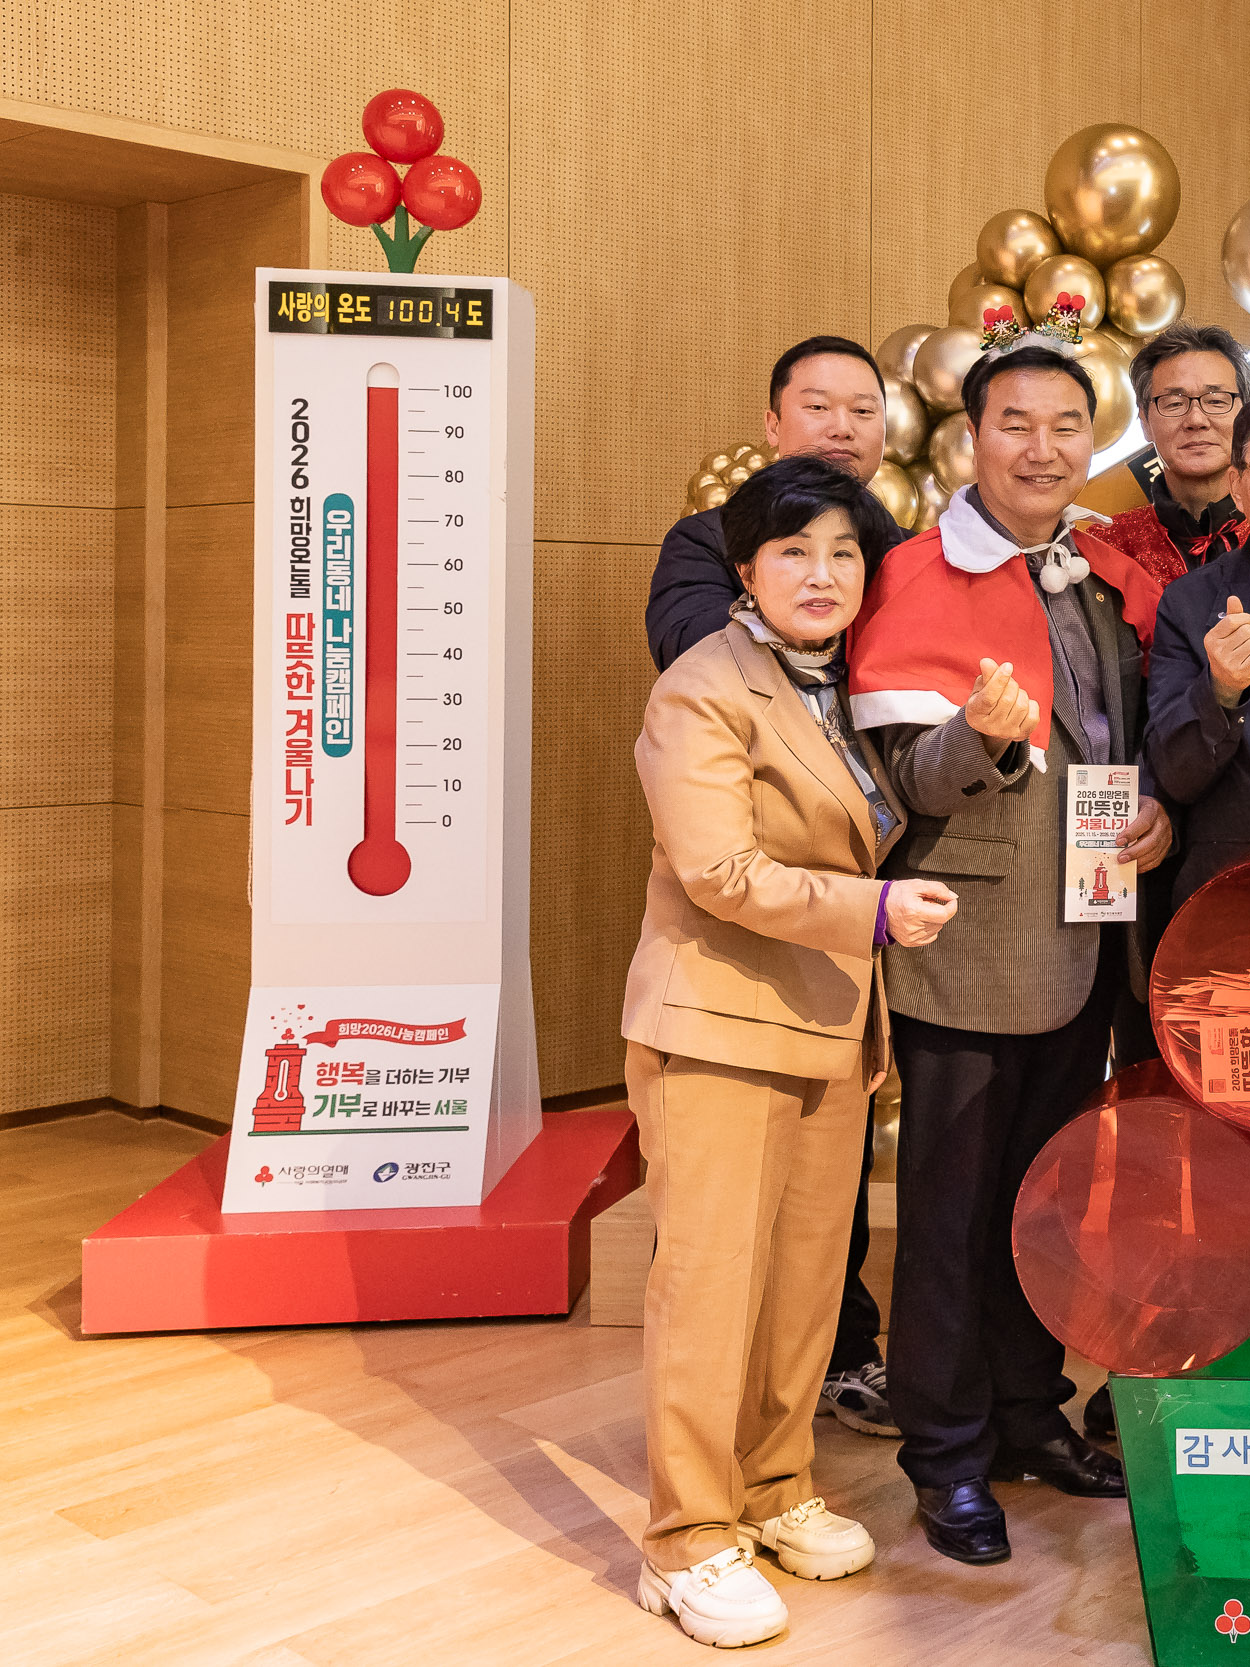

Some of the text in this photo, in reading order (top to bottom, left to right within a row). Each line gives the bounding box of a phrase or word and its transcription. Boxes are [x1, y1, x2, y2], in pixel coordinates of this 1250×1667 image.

[278, 291, 330, 322] 사랑의
[337, 294, 371, 323] 온도
[443, 385, 472, 398] 100
[444, 426, 464, 439] 90
[444, 470, 464, 484] 80
[444, 514, 464, 527] 70
[444, 558, 464, 571] 60
[285, 398, 316, 826] 2026 희망온돌 따뜻한 겨울나기
[443, 602, 463, 615] 50
[325, 509, 352, 745] 우리동네 나눔캠페인
[442, 648, 463, 660] 40
[442, 693, 462, 706] 30
[442, 738, 462, 751] 20
[443, 779, 462, 792] 10
[1077, 790, 1130, 800] 2026 희망온돌
[1076, 800, 1130, 817] 따뜻한
[442, 815, 452, 827] 0
[1076, 818, 1128, 830] 겨울나기
[338, 1022, 449, 1042] 희망2026나눔캠페인
[316, 1062, 470, 1086] 행복을 더하는 기부
[1232, 1068, 1240, 1091] 2026
[312, 1094, 468, 1118] 기부로 바꾸는 서울
[404, 1162, 452, 1174] 광진구
